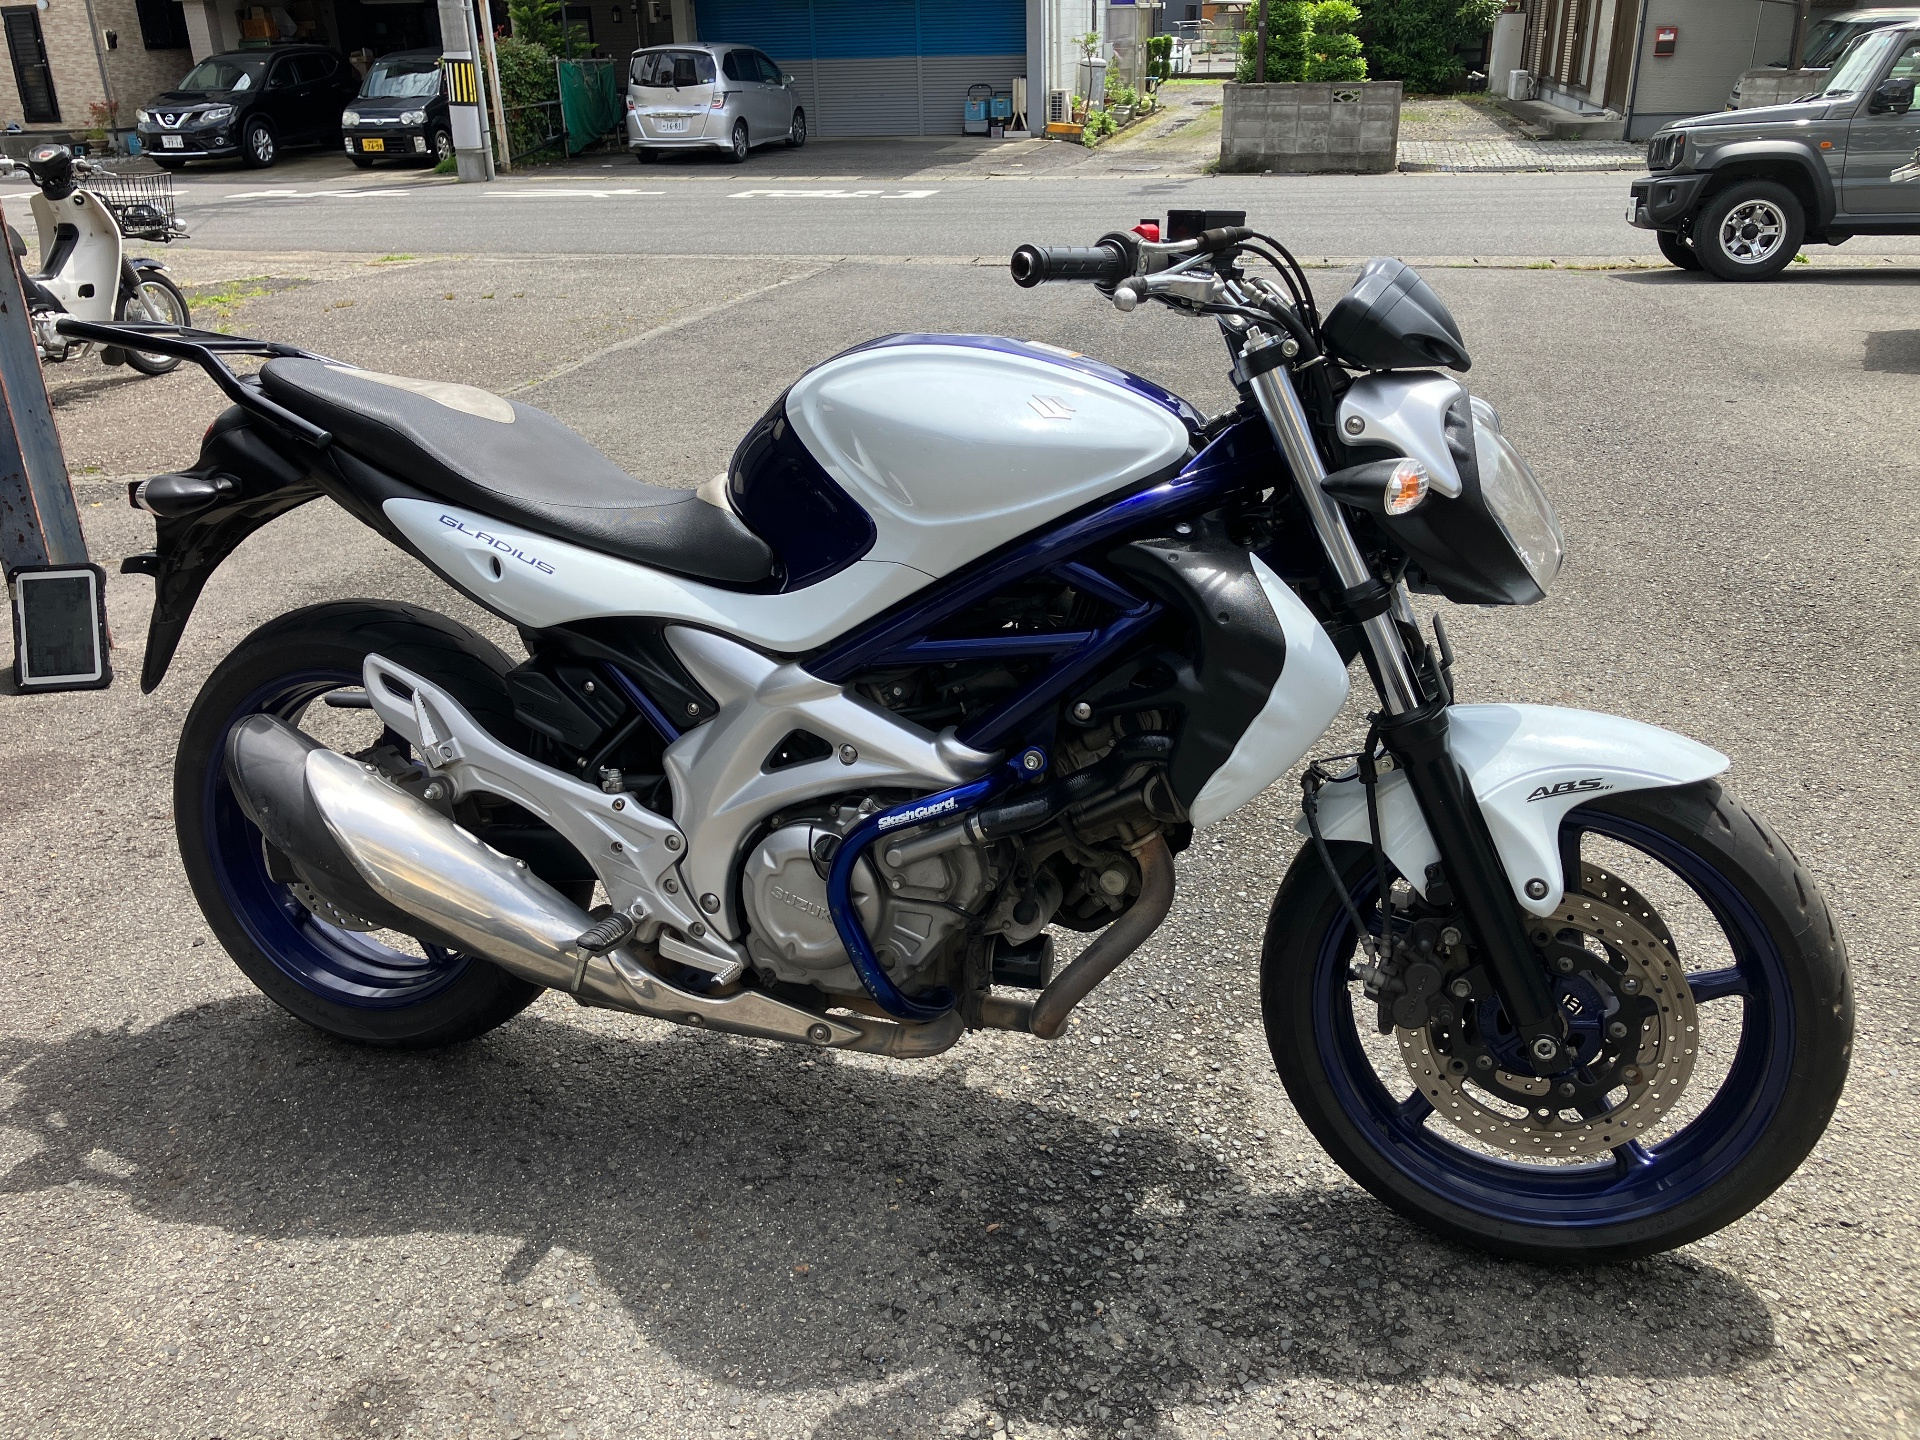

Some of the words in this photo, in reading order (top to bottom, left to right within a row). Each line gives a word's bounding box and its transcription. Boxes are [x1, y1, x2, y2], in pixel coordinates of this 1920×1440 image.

[439, 514, 556, 575] GLADIUS
[1526, 777, 1604, 801] ABS
[771, 885, 833, 923] SUZUK
